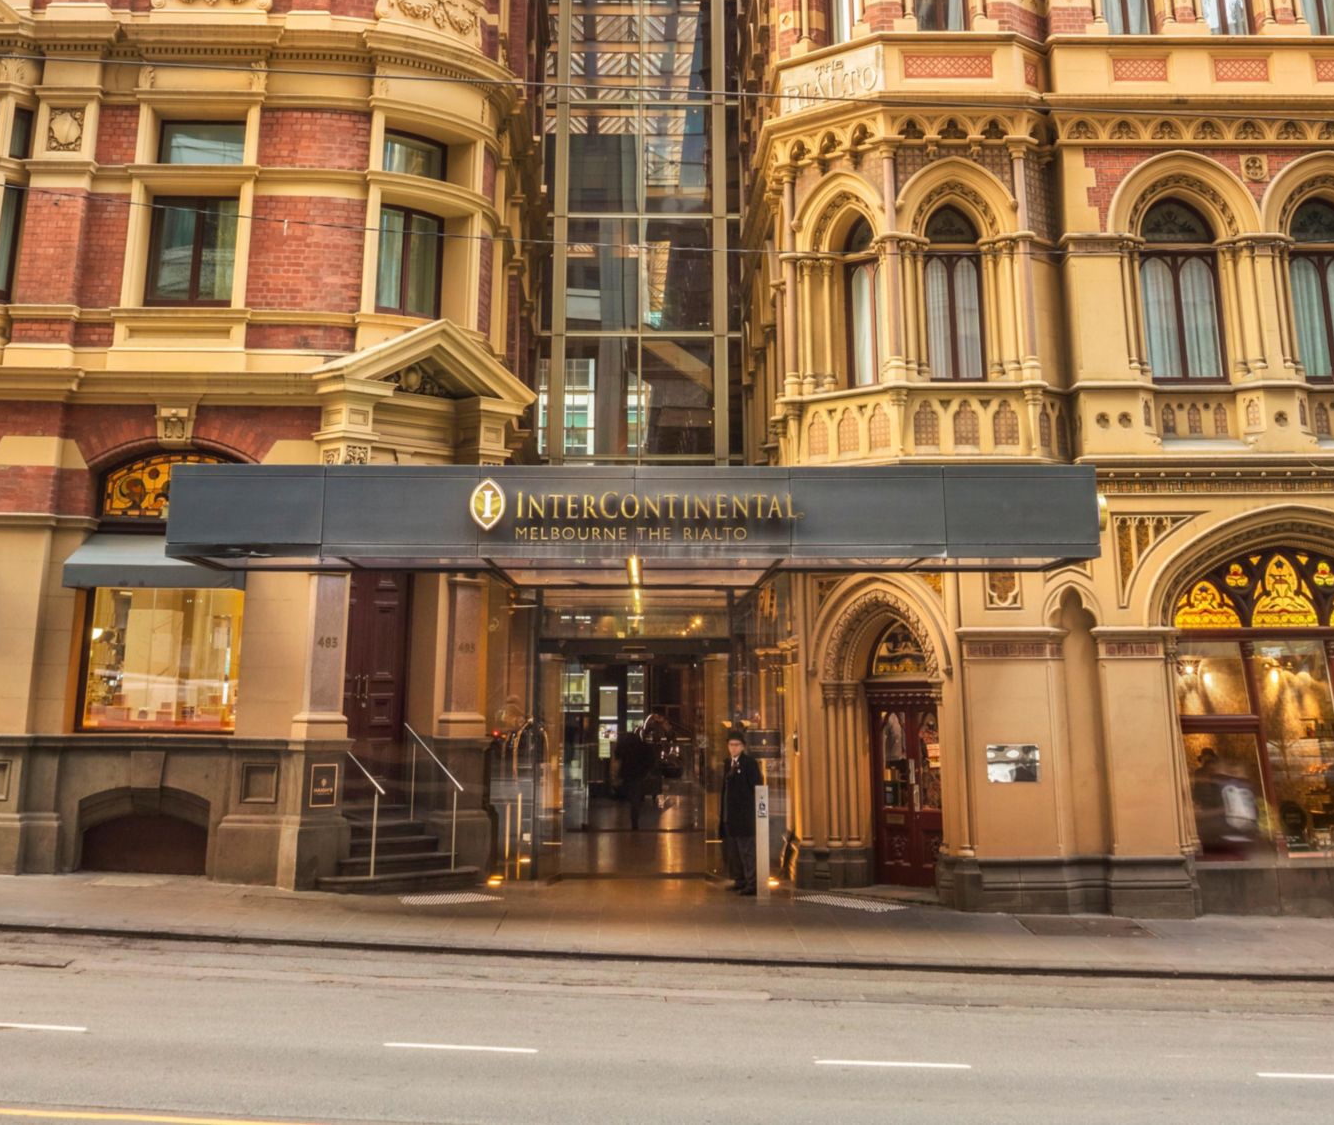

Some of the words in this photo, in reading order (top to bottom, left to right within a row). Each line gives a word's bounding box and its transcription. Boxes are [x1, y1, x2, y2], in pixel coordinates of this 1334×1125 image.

[814, 59, 845, 75] THE
[783, 66, 878, 114] RIALTO
[514, 526, 628, 541] MELBOURNE
[636, 526, 672, 541] THE
[683, 526, 748, 541] RIALTO
